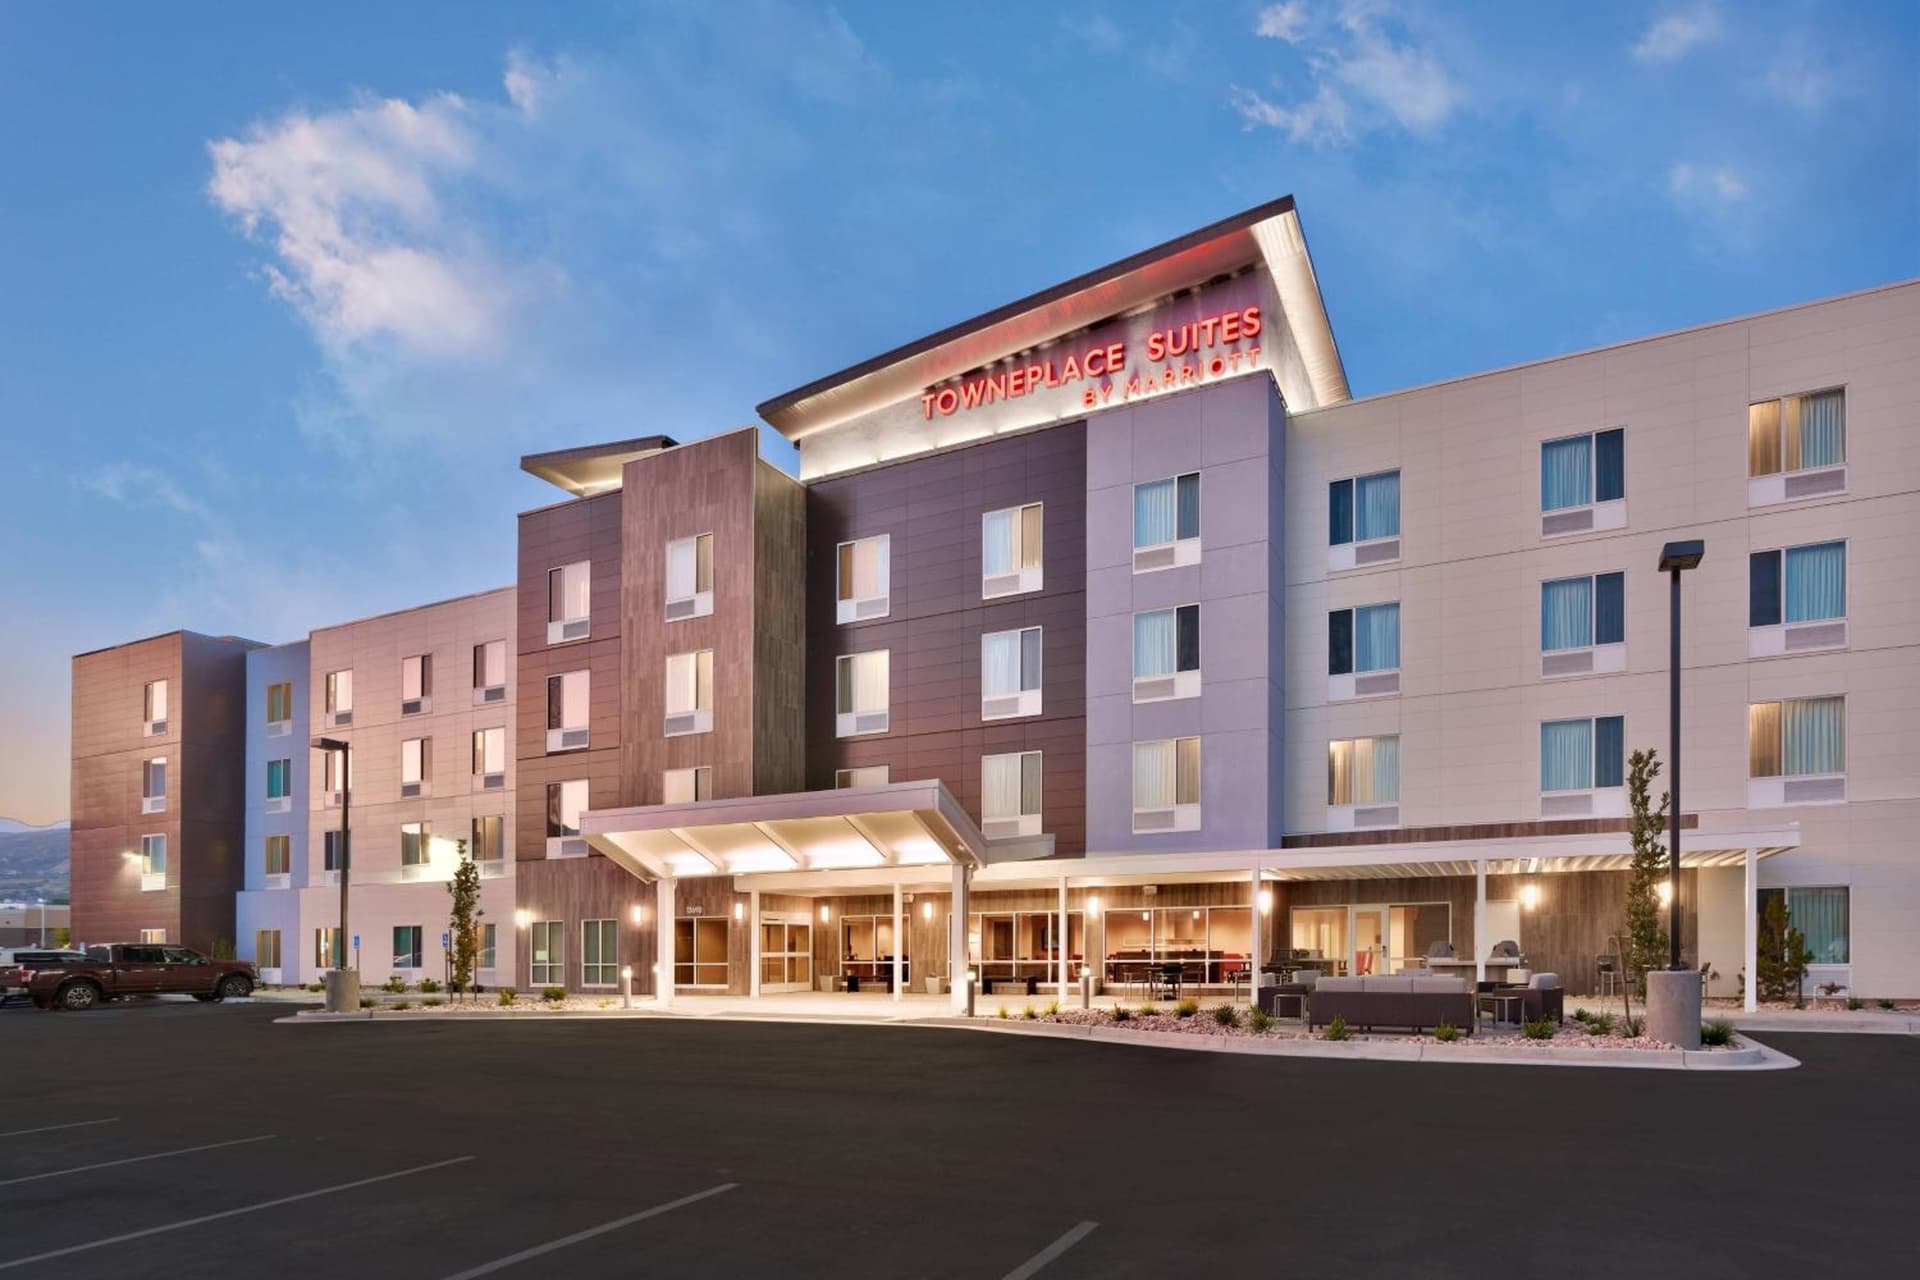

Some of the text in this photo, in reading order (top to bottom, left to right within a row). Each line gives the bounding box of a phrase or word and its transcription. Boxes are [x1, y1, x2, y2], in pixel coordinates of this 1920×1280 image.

[921, 306, 1262, 420] TOWNEPLACE SUITES
[1082, 347, 1261, 408] BY MARRIOTT
